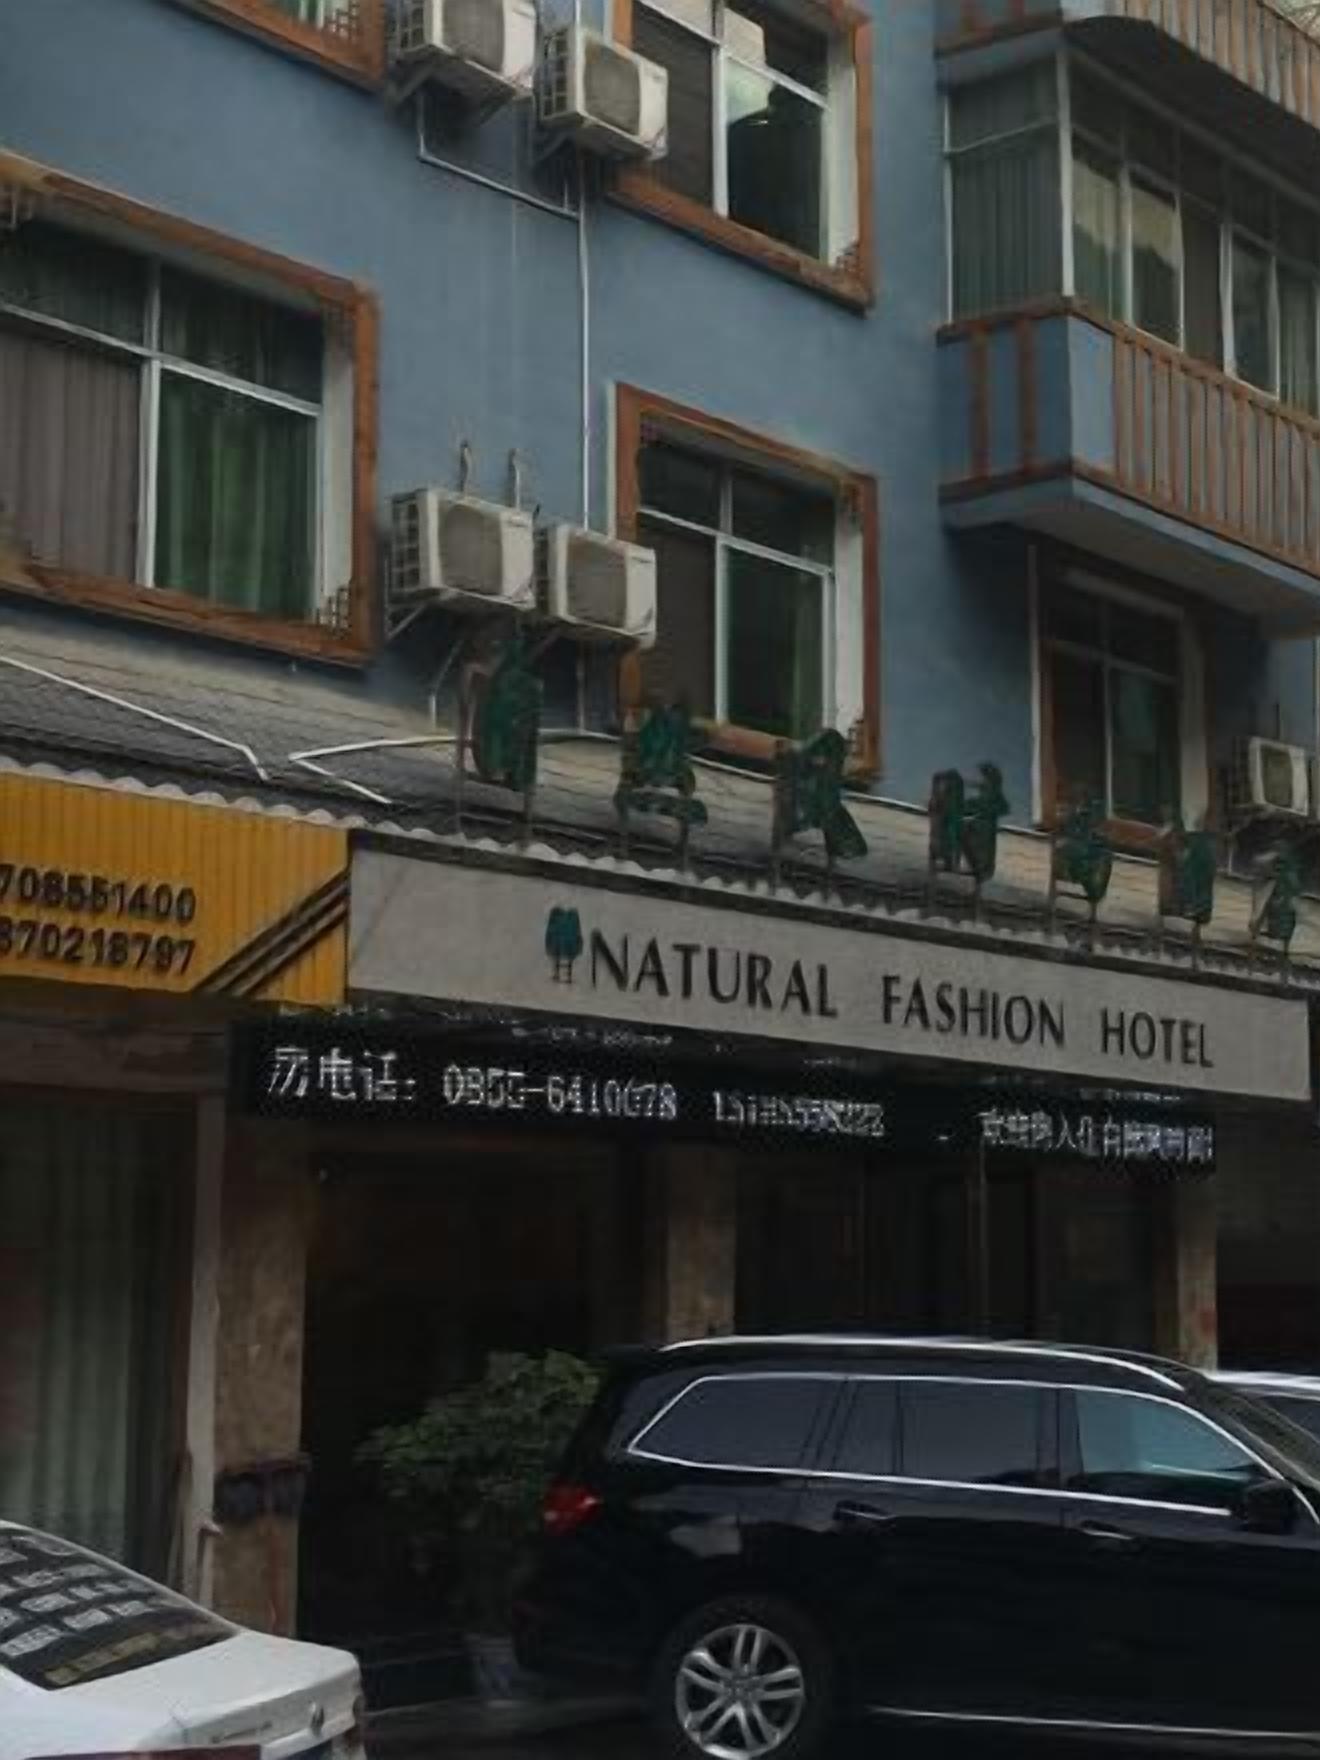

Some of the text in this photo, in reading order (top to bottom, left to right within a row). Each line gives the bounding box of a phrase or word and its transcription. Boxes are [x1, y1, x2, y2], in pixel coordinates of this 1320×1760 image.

[590, 928, 1214, 1068] NATURAL FASHION HOTEL
